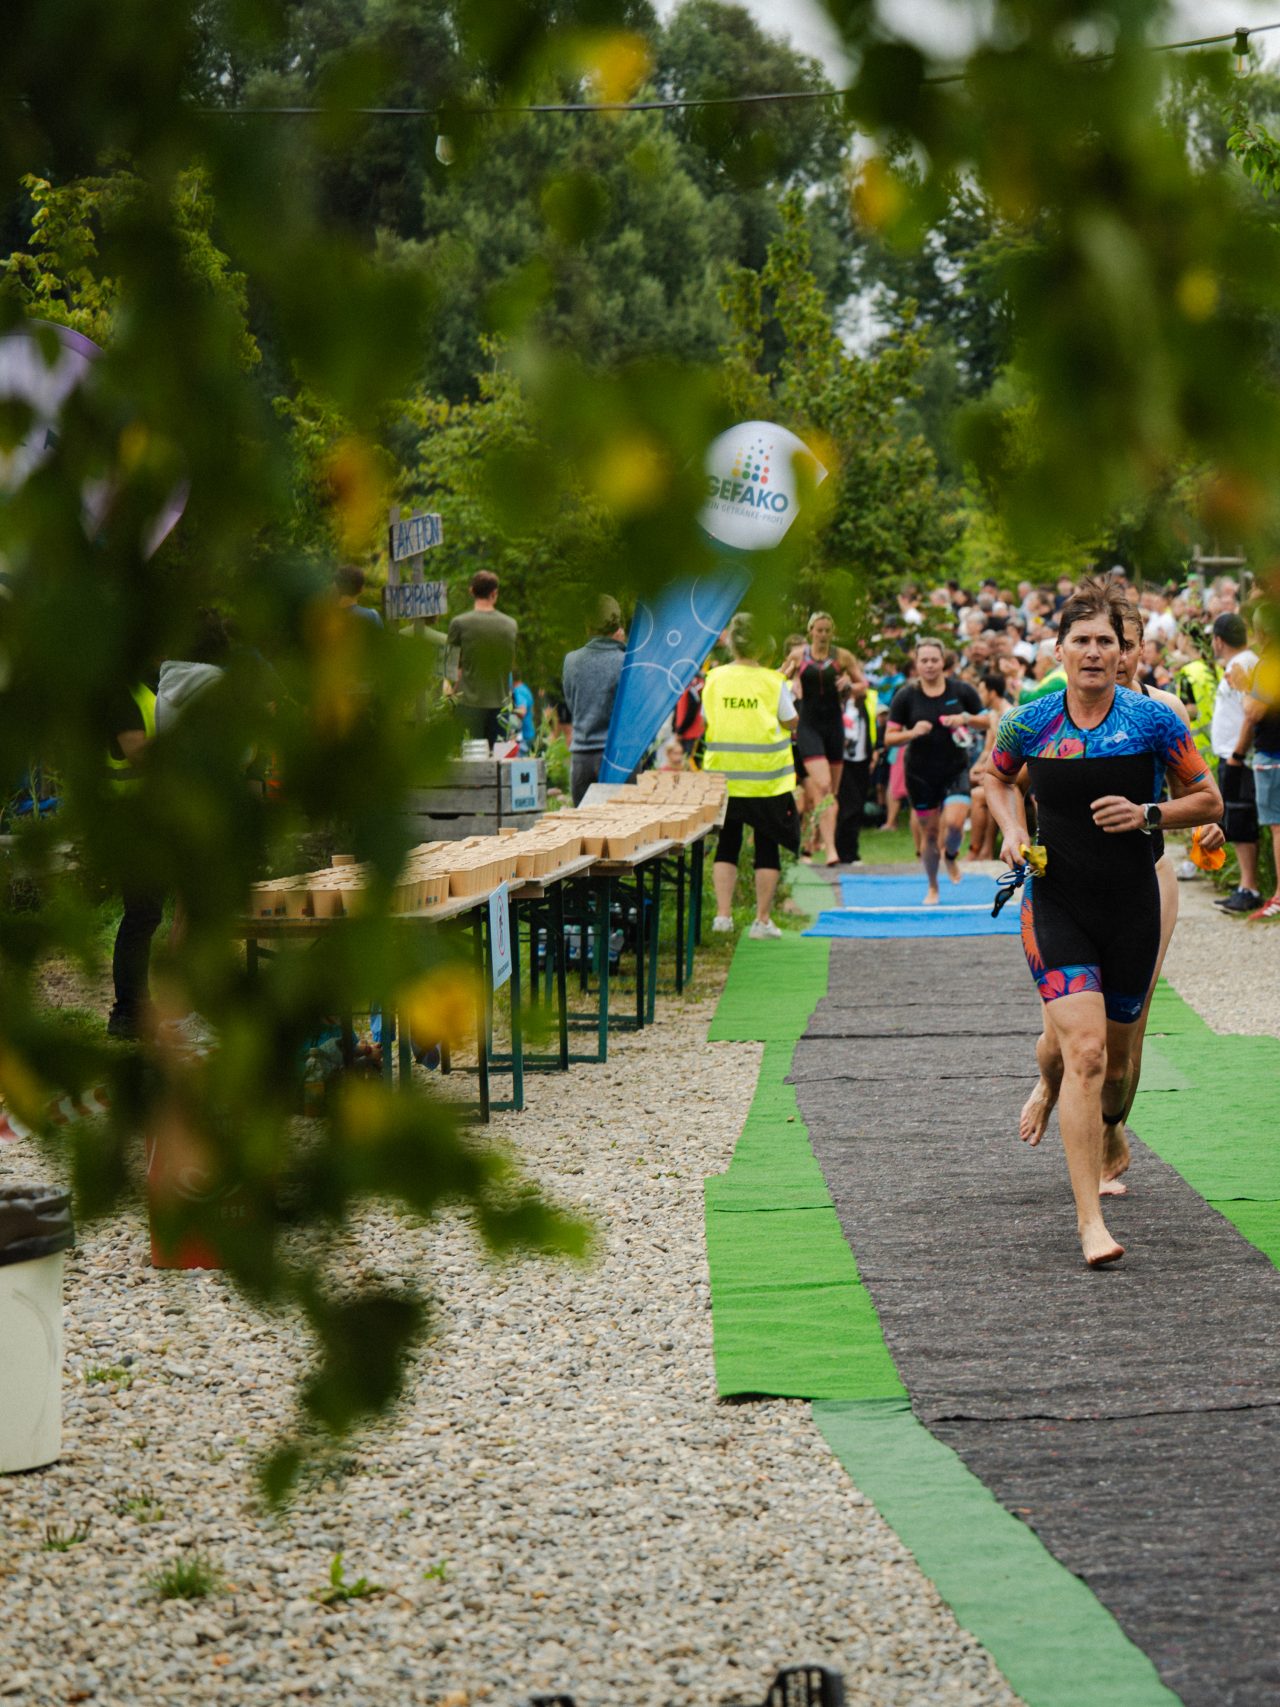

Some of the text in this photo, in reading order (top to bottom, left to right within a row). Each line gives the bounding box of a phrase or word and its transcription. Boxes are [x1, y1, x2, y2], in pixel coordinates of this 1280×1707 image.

[707, 475, 788, 513] GEFAKO
[396, 514, 440, 558] AKTION
[722, 697, 759, 709] TEAM
